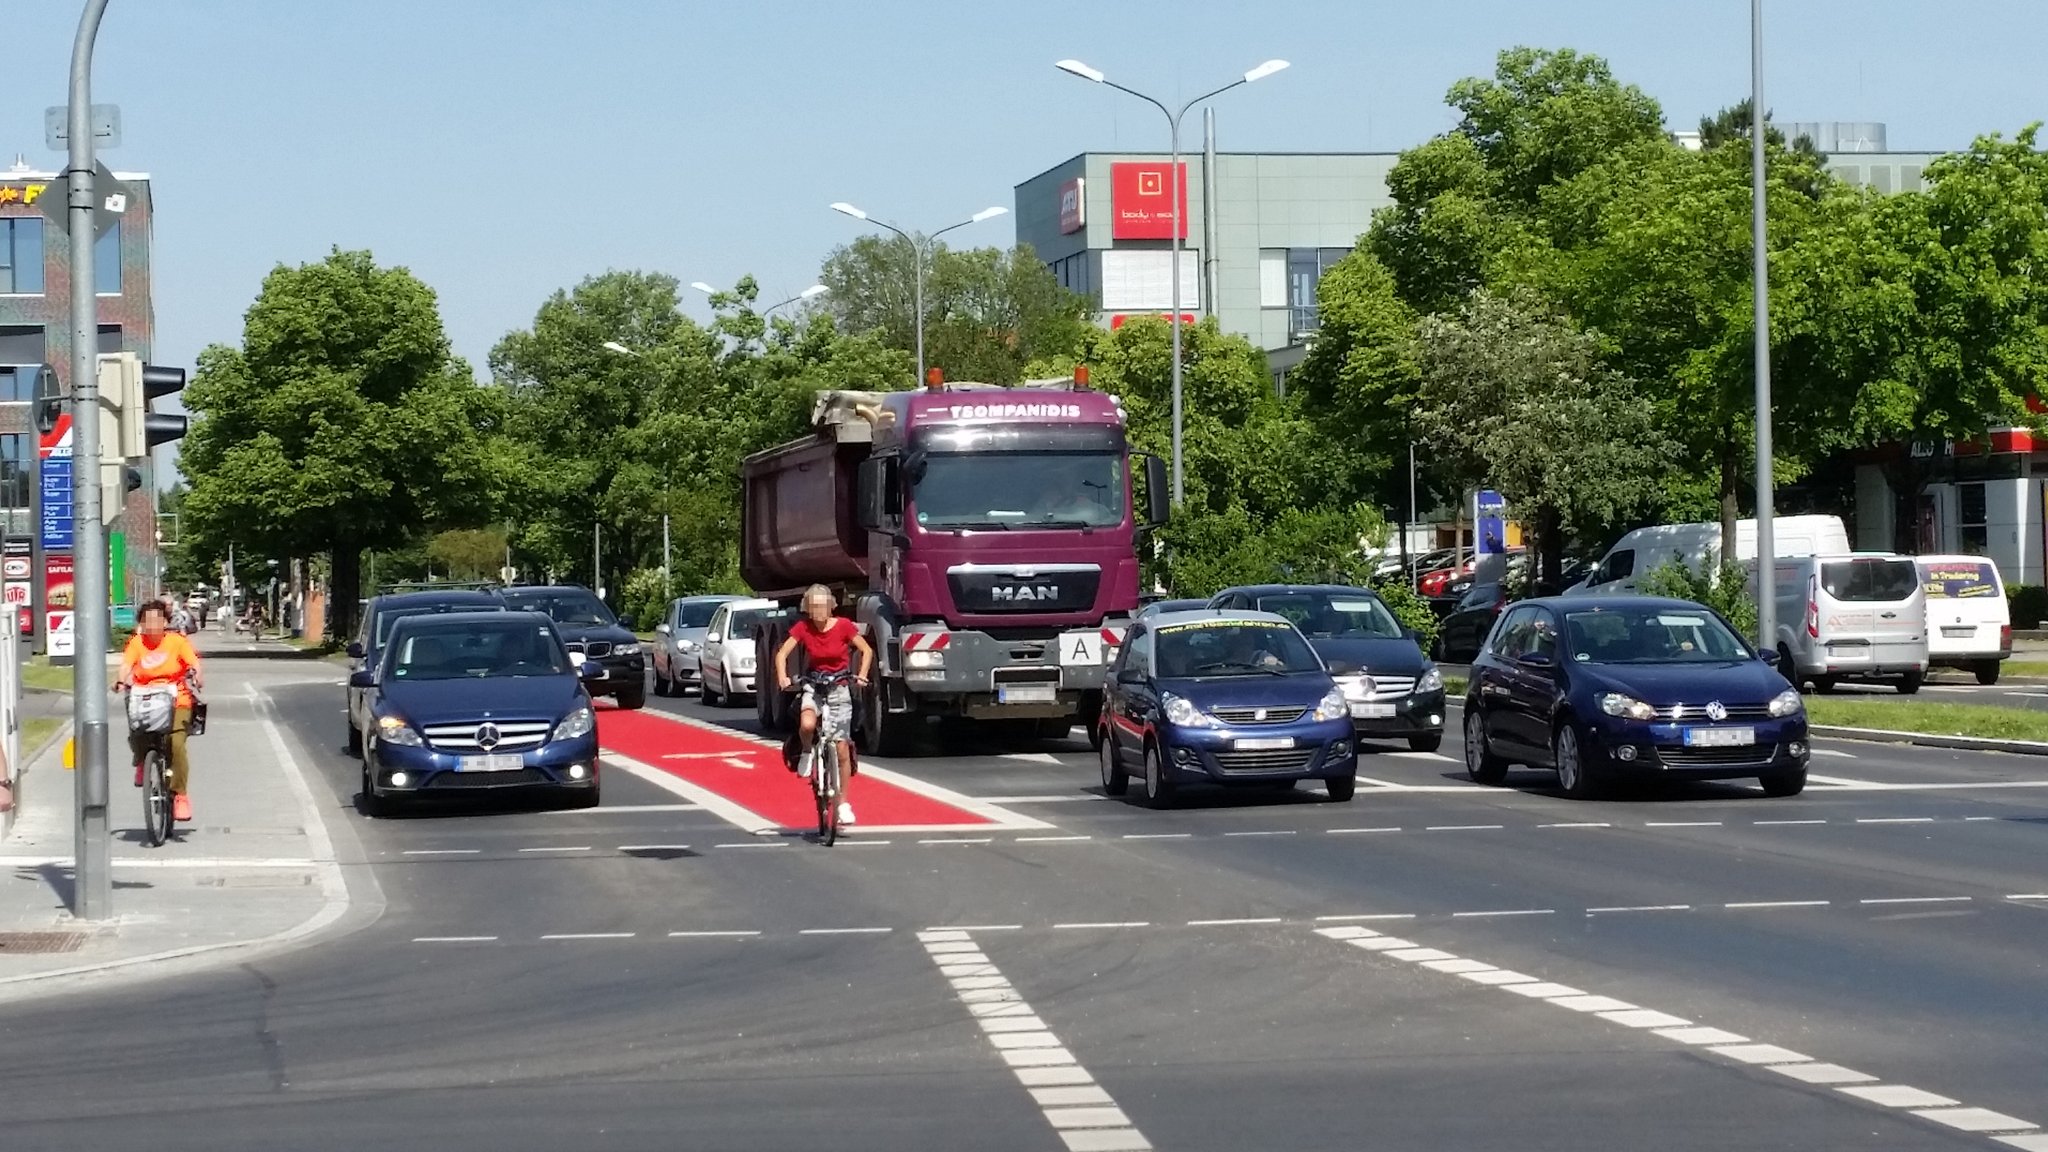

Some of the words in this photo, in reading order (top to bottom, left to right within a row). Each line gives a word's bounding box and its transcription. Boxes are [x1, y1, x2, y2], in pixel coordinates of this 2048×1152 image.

[1121, 208, 1149, 220] body
[950, 404, 1080, 419] TSOMPANIDIS
[991, 586, 1059, 601] MAN
[1072, 637, 1090, 660] A
